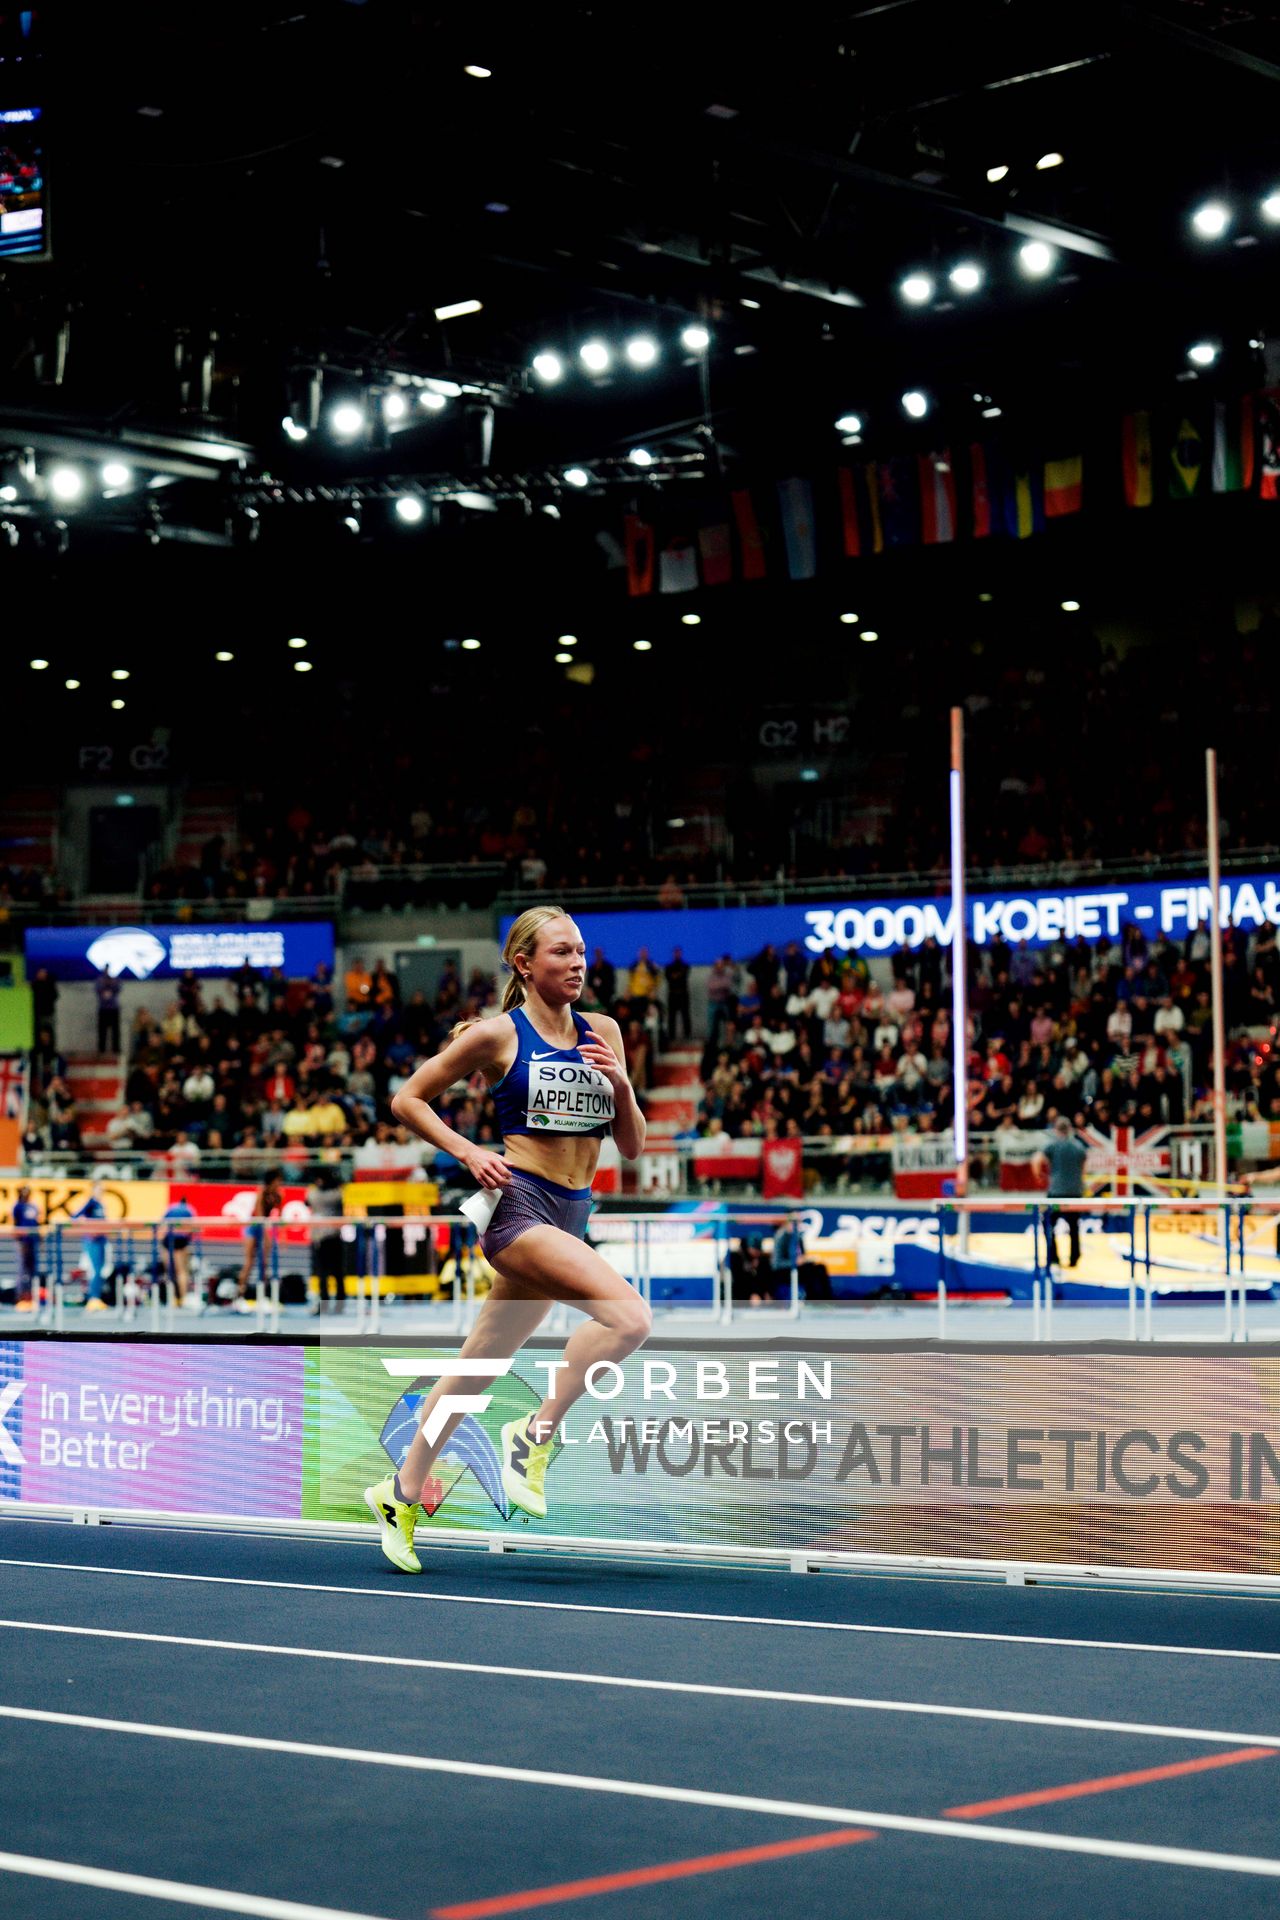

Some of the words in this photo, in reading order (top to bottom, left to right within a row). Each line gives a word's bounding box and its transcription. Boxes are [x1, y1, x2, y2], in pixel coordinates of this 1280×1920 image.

[758, 719, 799, 748] G2
[79, 745, 115, 770] F2
[129, 744, 171, 770] G2
[804, 904, 954, 953] 3000M
[974, 893, 1128, 945] KOBIET
[539, 1067, 604, 1086] SONY
[533, 1089, 611, 1115] APPLETON
[554, 1119, 577, 1127] KUJAWY
[641, 1155, 680, 1190] H1
[39, 1383, 70, 1421] In
[79, 1384, 292, 1442] Everything,
[39, 1428, 155, 1471] Better
[602, 1414, 818, 1481] WORLD
[835, 1421, 1209, 1498] ATHLETICS
